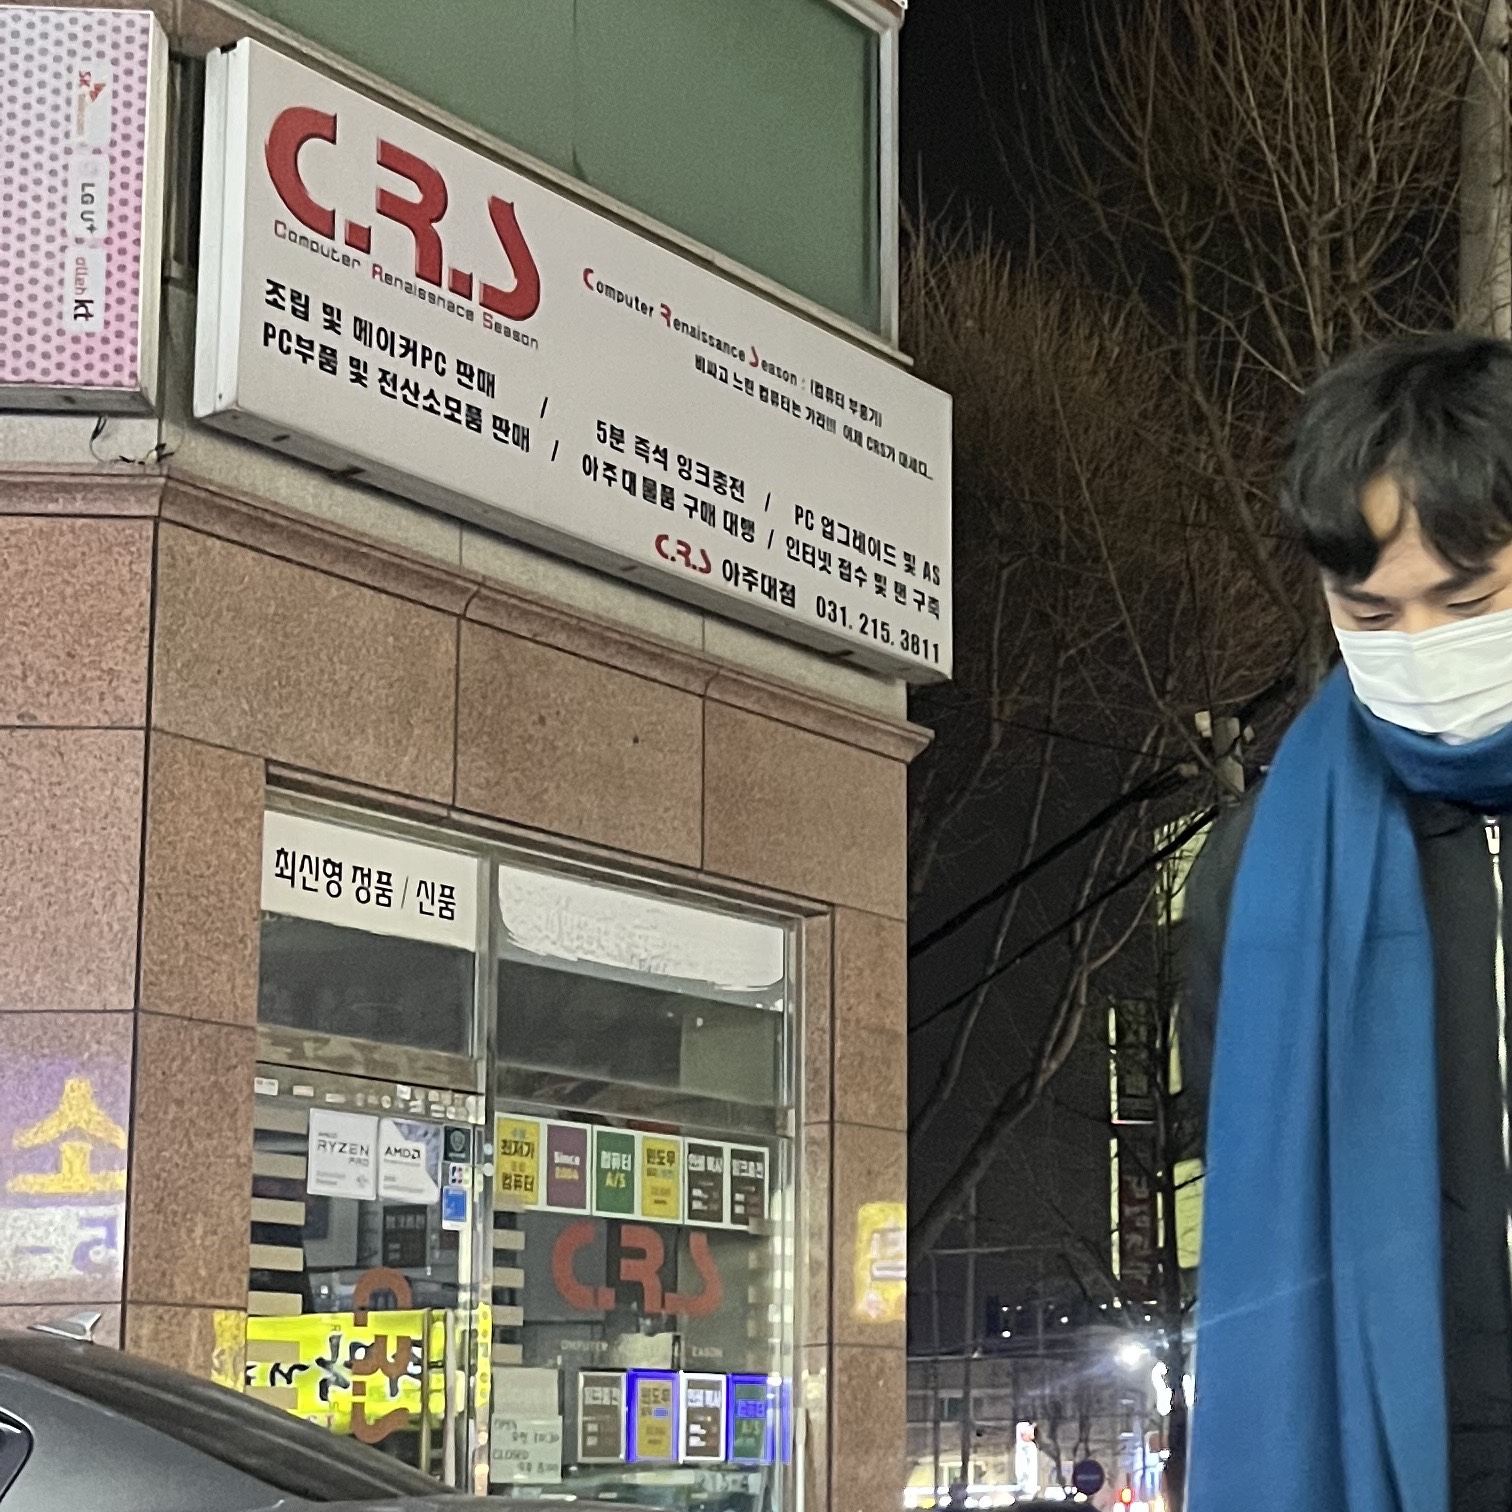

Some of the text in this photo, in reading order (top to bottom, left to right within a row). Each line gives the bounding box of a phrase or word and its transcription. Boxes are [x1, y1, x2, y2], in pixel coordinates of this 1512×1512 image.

[80, 183, 96, 205] LG
[74, 299, 94, 322] kt
[274, 219, 361, 270] Computer
[482, 311, 539, 350] Season
[583, 267, 655, 318] Computer
[660, 303, 746, 362] Renaissance
[263, 321, 338, 376] PC부품
[349, 355, 368, 388] 및
[377, 366, 483, 434] 전산소모품
[492, 414, 530, 453] 판매
[683, 493, 716, 528] 구매
[723, 509, 755, 543] 대행
[786, 536, 832, 575] 인터넷
[838, 557, 868, 588] 접수
[874, 572, 887, 598] 및
[265, 278, 310, 322] 조립
[322, 302, 342, 336] 및
[353, 315, 447, 377] 메이커PC
[456, 358, 496, 399] 판매
[596, 419, 625, 454] 5분
[634, 435, 668, 471] 즉석
[677, 454, 745, 504] 잉크충전
[795, 504, 814, 530] PC
[821, 516, 897, 567] 업그레이드
[903, 551, 916, 576] 및
[923, 560, 941, 586] AS
[722, 558, 796, 609] 아주대점
[274, 847, 343, 899] 최신형
[351, 865, 394, 908] 정품
[416, 880, 456, 921] 신품
[317, 1139, 370, 1157] RYZEN
